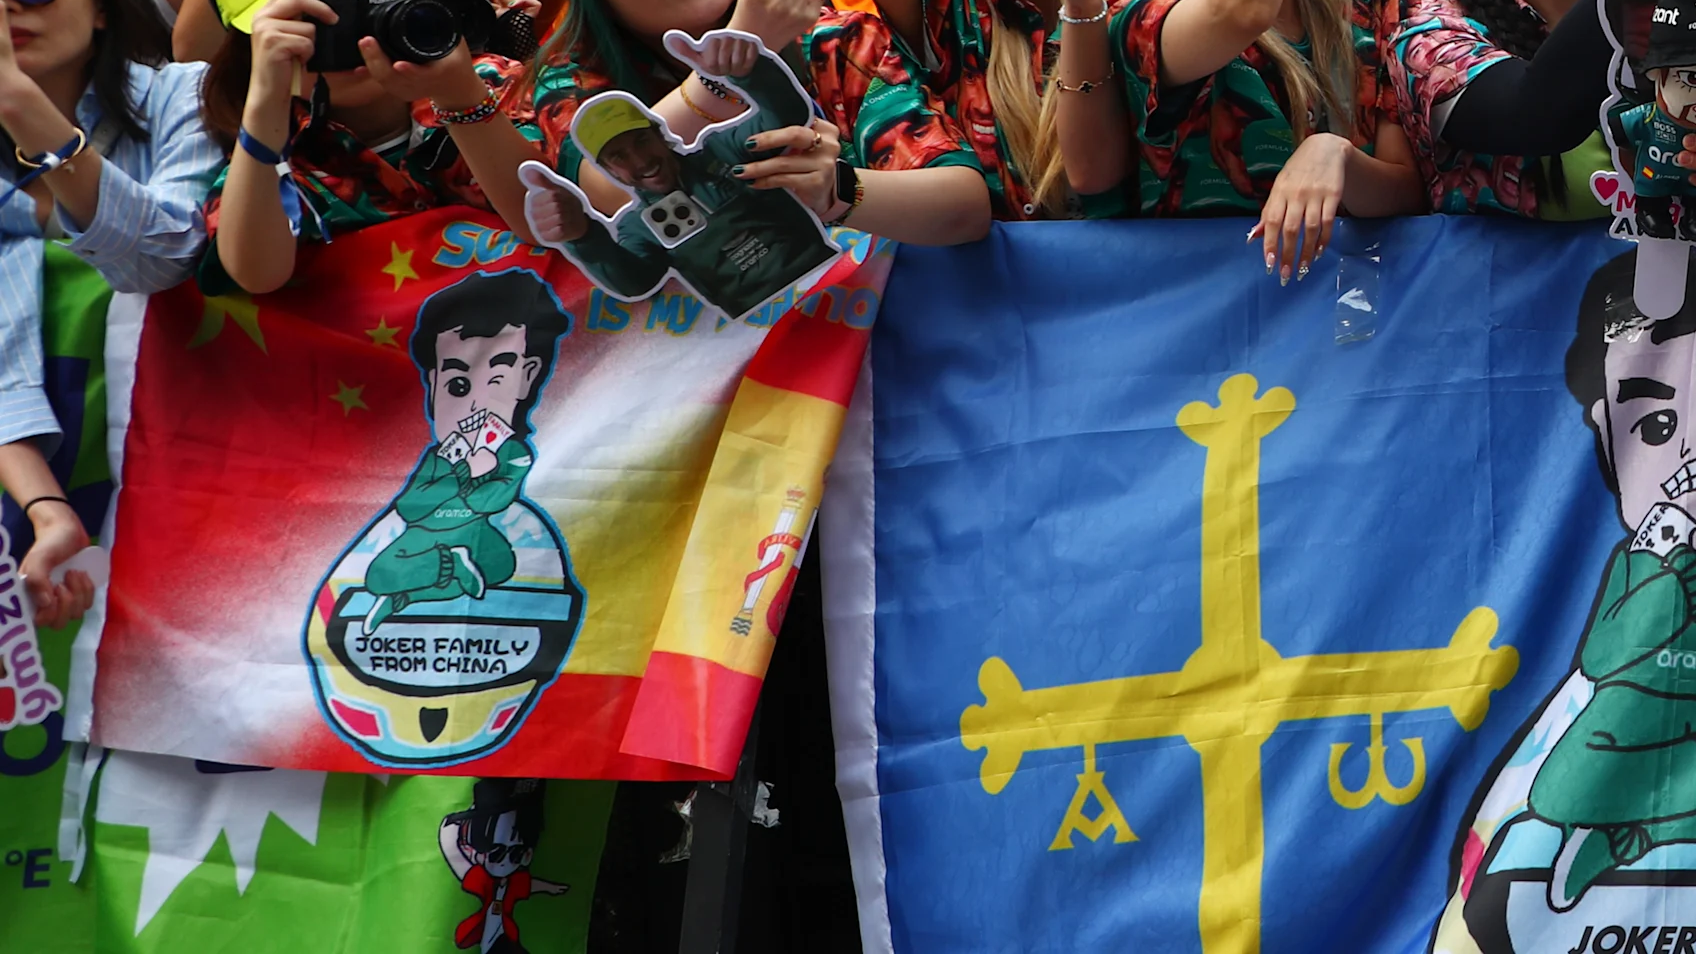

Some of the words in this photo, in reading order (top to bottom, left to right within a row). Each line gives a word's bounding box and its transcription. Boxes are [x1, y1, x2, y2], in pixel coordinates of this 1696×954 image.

[1653, 121, 1677, 134] BOSS
[434, 507, 473, 519] aramco
[1632, 504, 1669, 549] JOKER
[355, 637, 426, 654] JOKER
[434, 637, 529, 656] FAMILY
[369, 655, 427, 673] FROM
[432, 656, 508, 675] CHINA
[1567, 924, 1695, 954] JOKER
